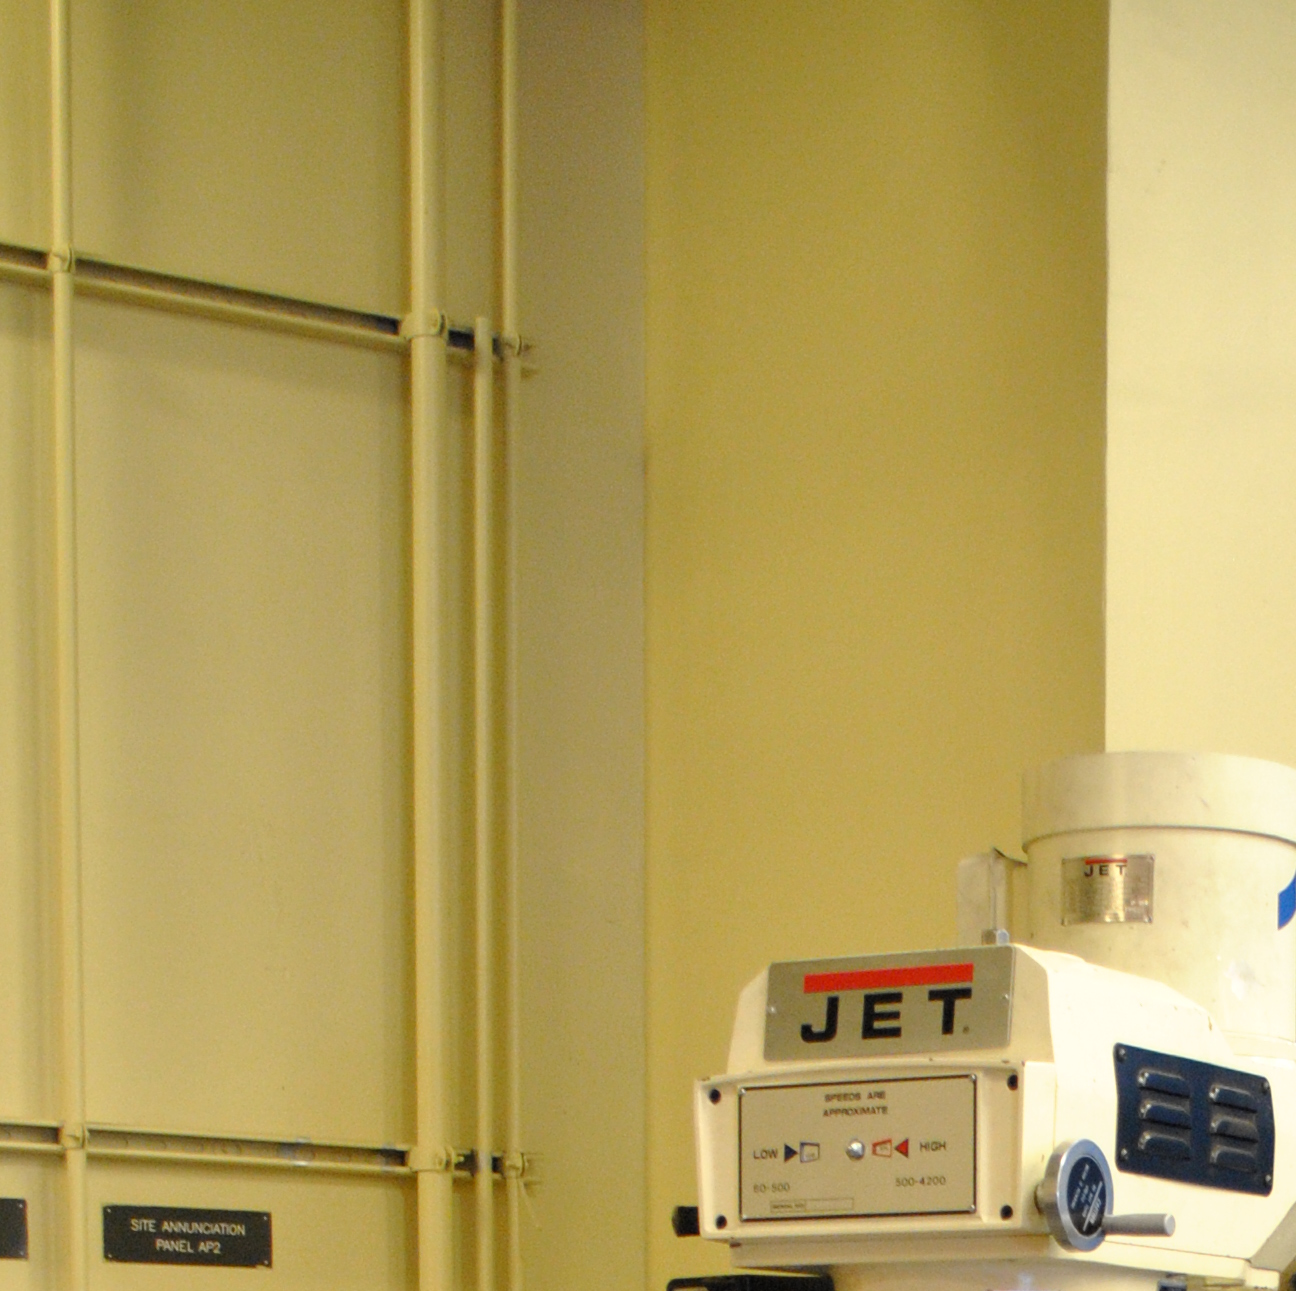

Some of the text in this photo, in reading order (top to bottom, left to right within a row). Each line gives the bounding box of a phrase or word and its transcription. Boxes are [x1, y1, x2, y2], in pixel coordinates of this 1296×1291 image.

[1084, 864, 1128, 877] JET
[801, 986, 973, 1044] JET
[919, 1141, 947, 1153] HIGH
[753, 1149, 779, 1160] LOW
[895, 1176, 947, 1188] 500-4200
[130, 1218, 246, 1237] SITE ANNUNCIATION
[155, 1238, 222, 1254] PANEL AP2
